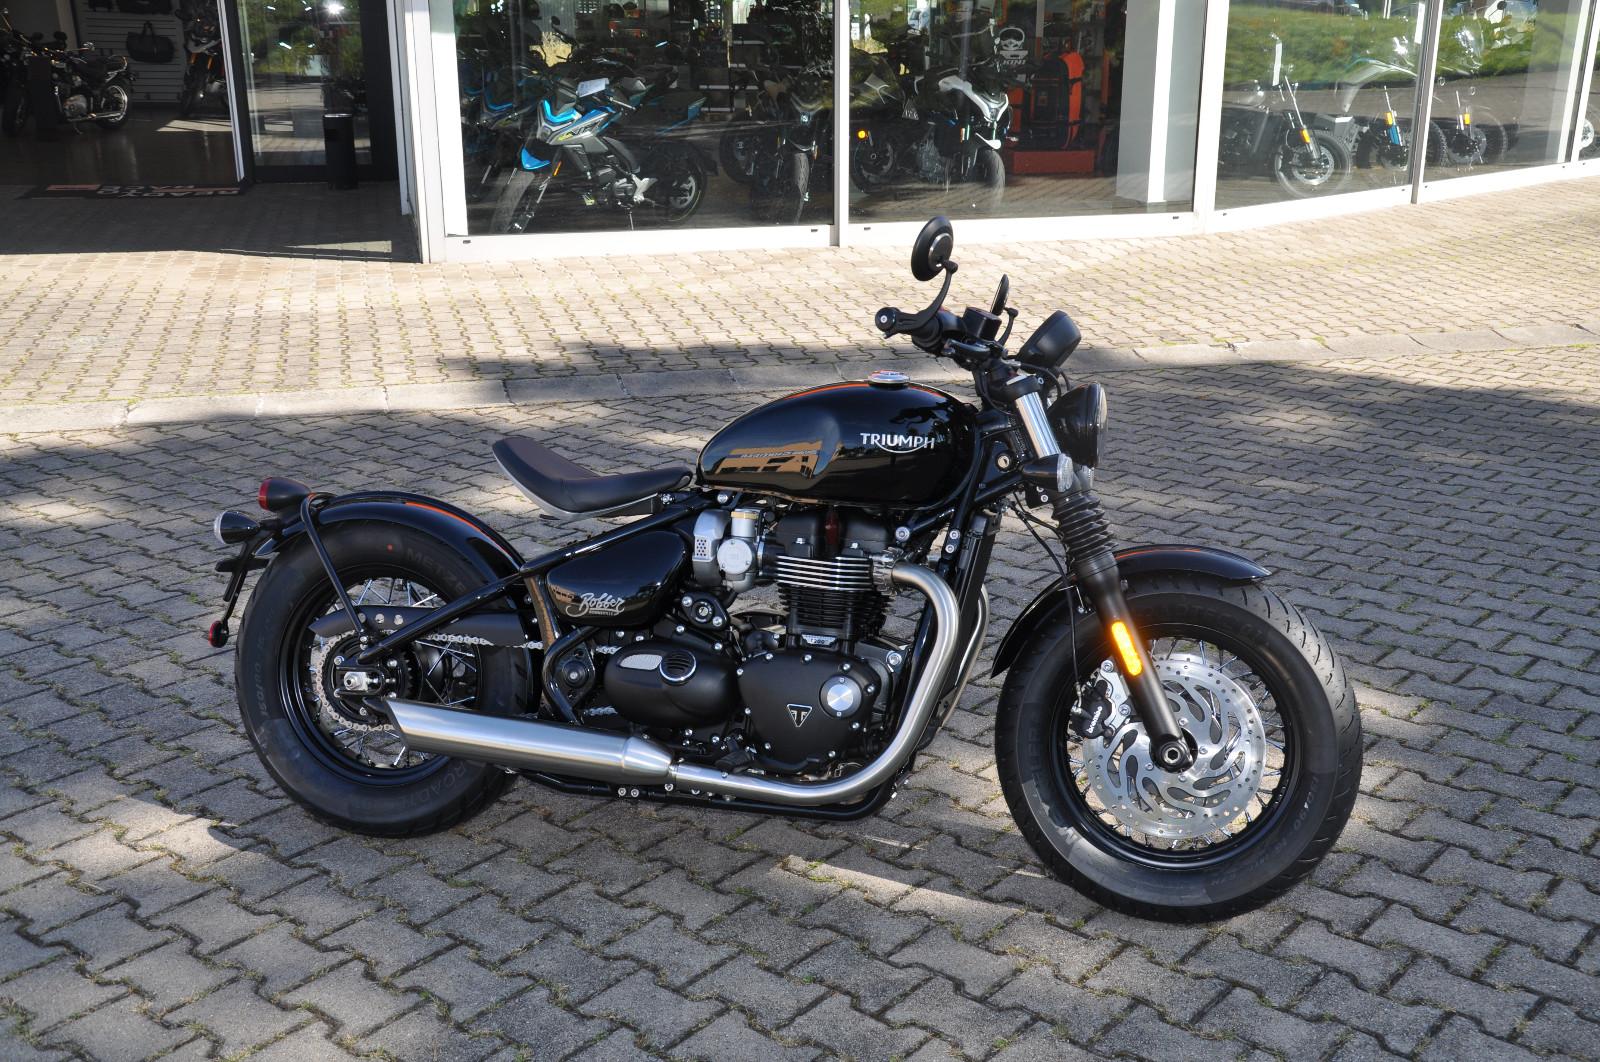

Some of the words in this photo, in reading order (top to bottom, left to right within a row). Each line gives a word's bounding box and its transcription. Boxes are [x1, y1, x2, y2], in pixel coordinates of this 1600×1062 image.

[860, 432, 935, 453] TRIUMPH
[570, 592, 625, 615] Bobber
[1086, 705, 1103, 734] brembo
